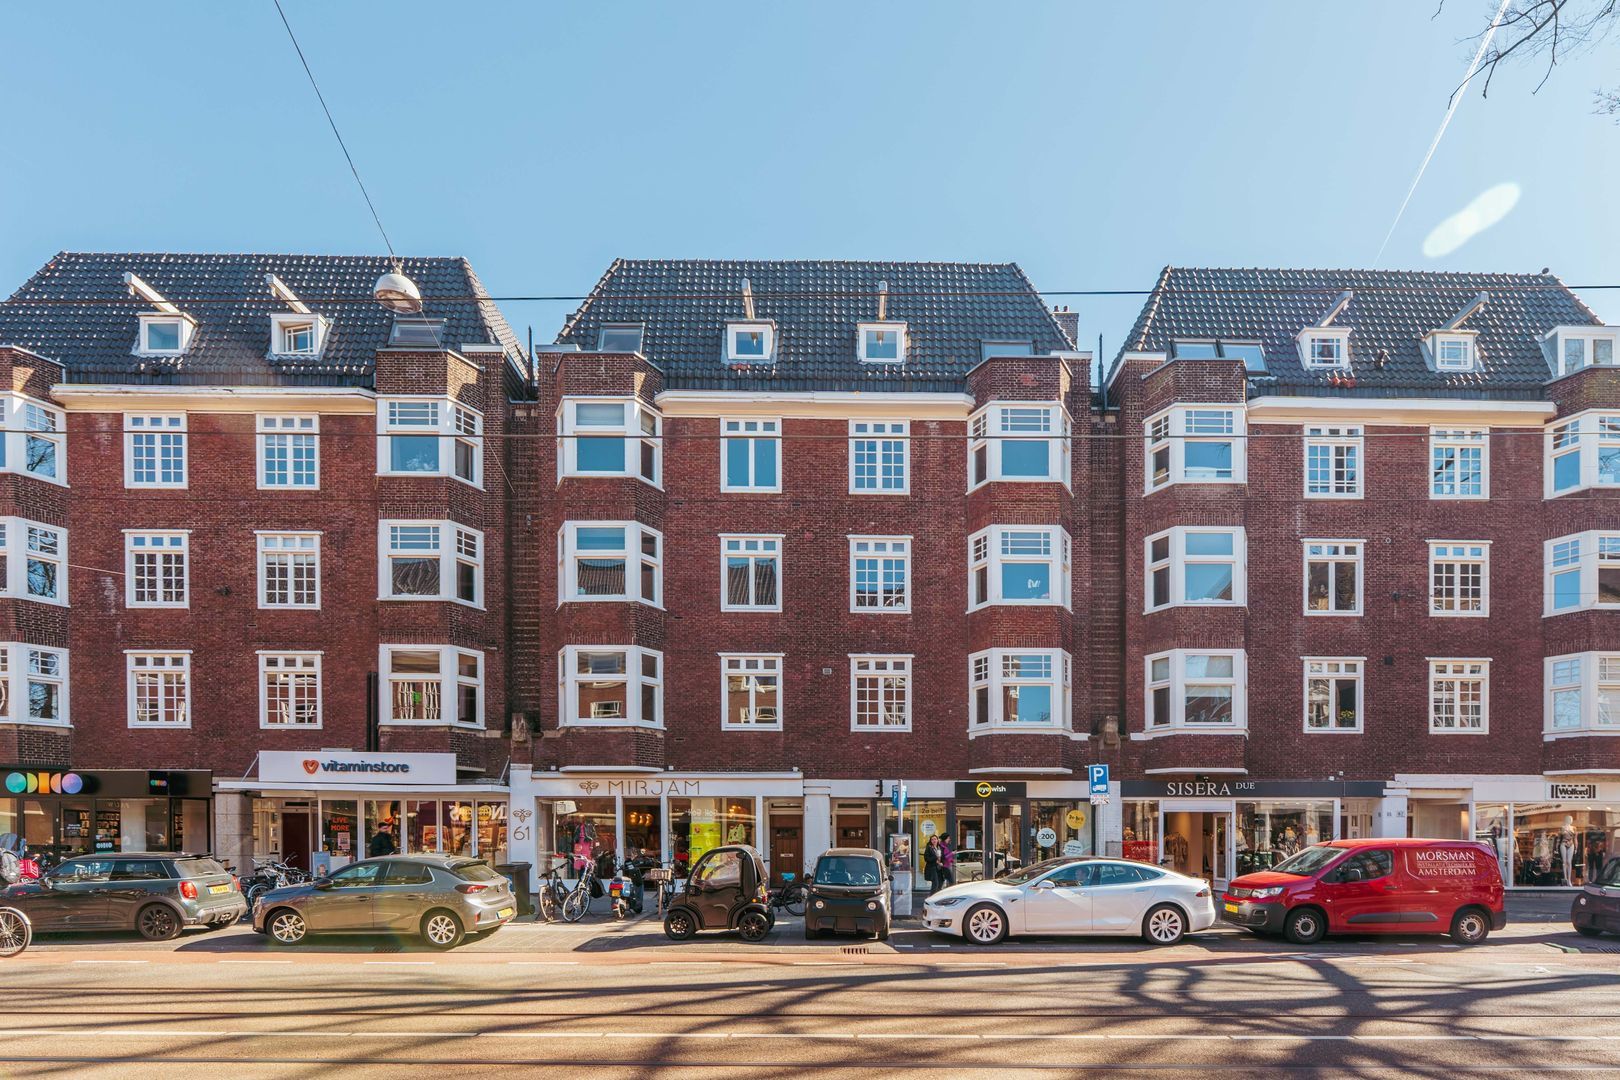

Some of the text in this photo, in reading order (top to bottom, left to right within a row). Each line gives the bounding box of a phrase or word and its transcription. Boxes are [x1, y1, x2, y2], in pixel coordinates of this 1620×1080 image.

[321, 760, 410, 773] vitaminstore
[1093, 767, 1104, 783] P
[608, 780, 700, 795] MIRJAM
[1166, 782, 1256, 796] SISERA DUE
[1558, 787, 1589, 796] Wolford
[513, 825, 530, 841] 61
[1416, 851, 1475, 861] MORSMAN
[1417, 868, 1476, 876] AMSTERDAM
